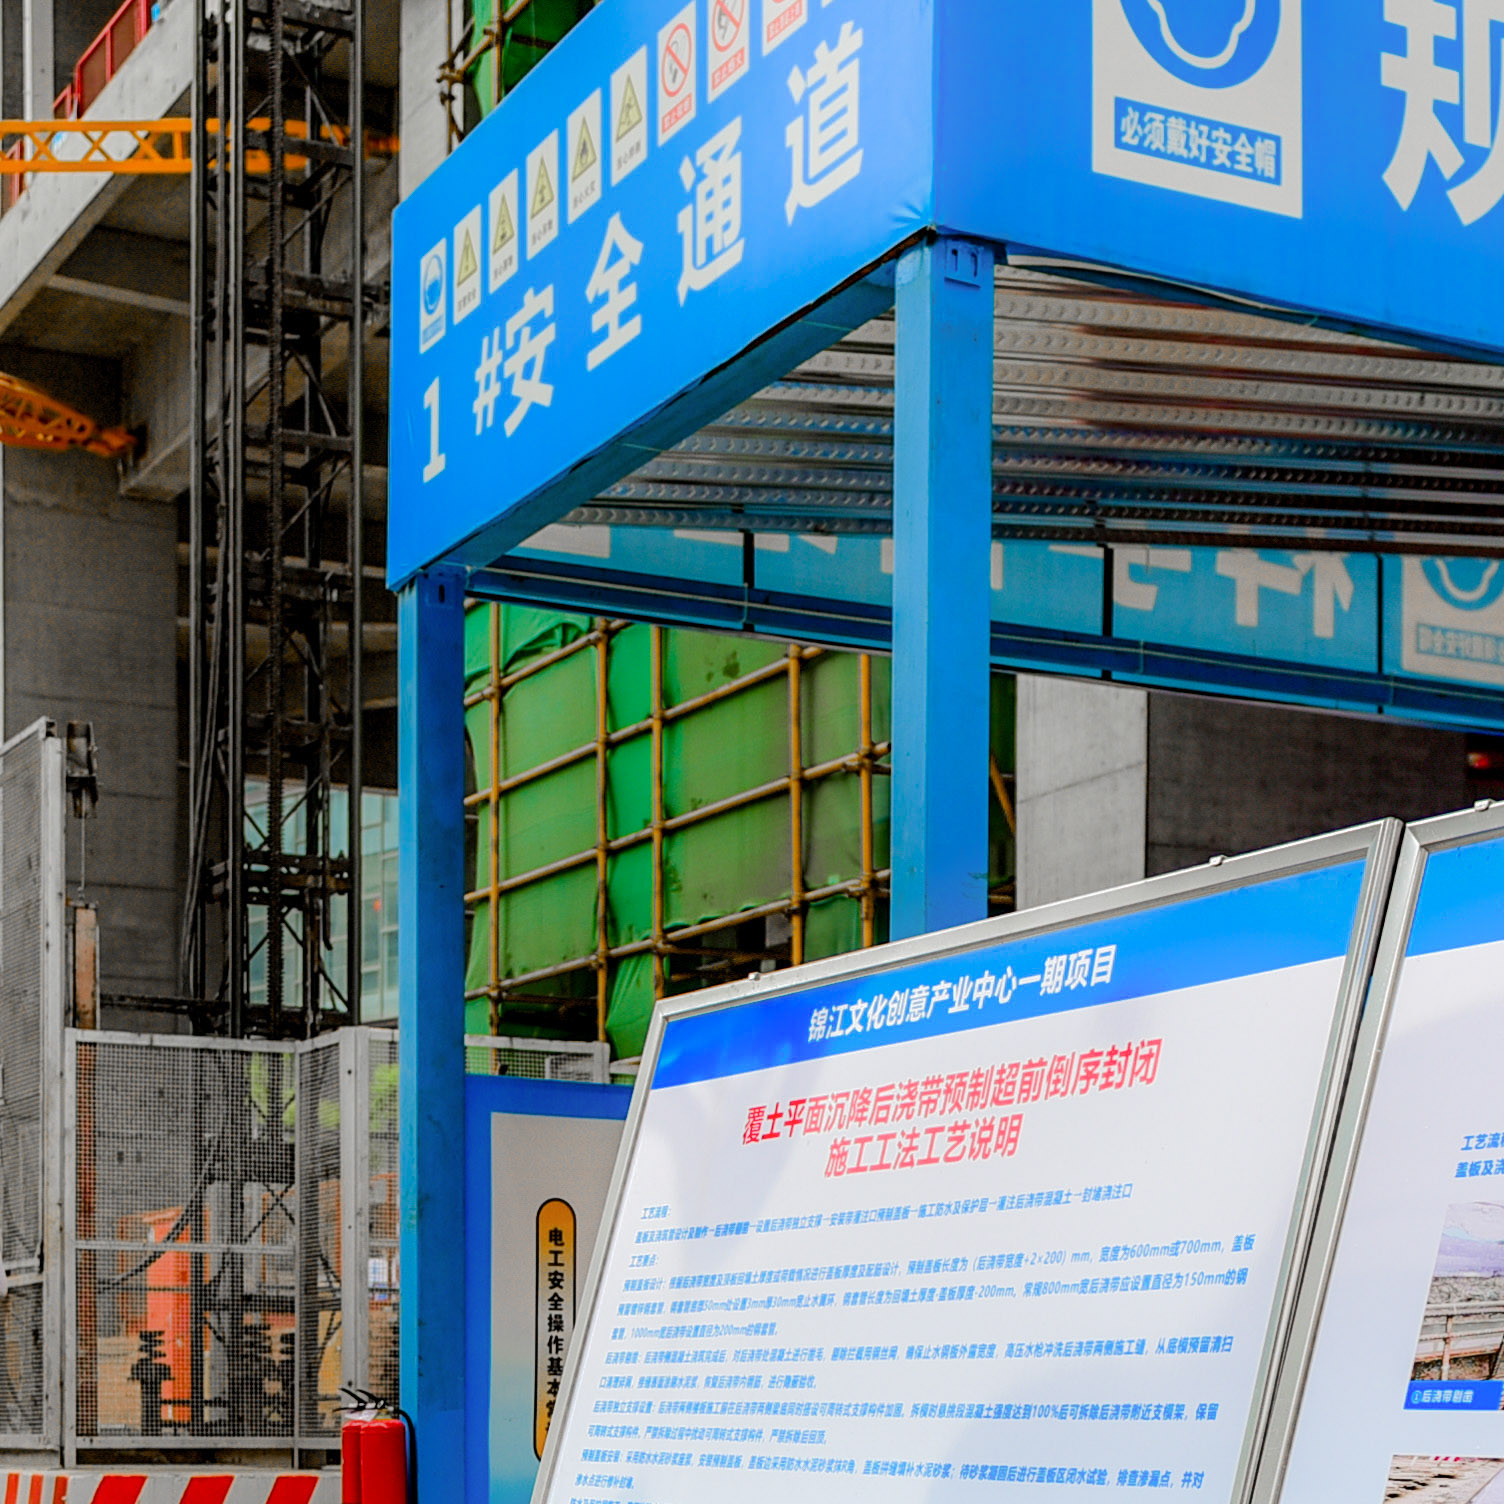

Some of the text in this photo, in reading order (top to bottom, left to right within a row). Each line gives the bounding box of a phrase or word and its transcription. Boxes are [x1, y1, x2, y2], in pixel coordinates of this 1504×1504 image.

[1121, 107, 1276, 179] 必须戴好安全帽
[807, 943, 1114, 1044] 锦江文化创意产业中心一期项目
[742, 1038, 1163, 1144] 覆土平面沉降后浇带预制超前倒序封闭
[824, 1116, 1022, 1179] 施工工法工艺说明
[545, 1227, 565, 1432] 电工安全操作基本
